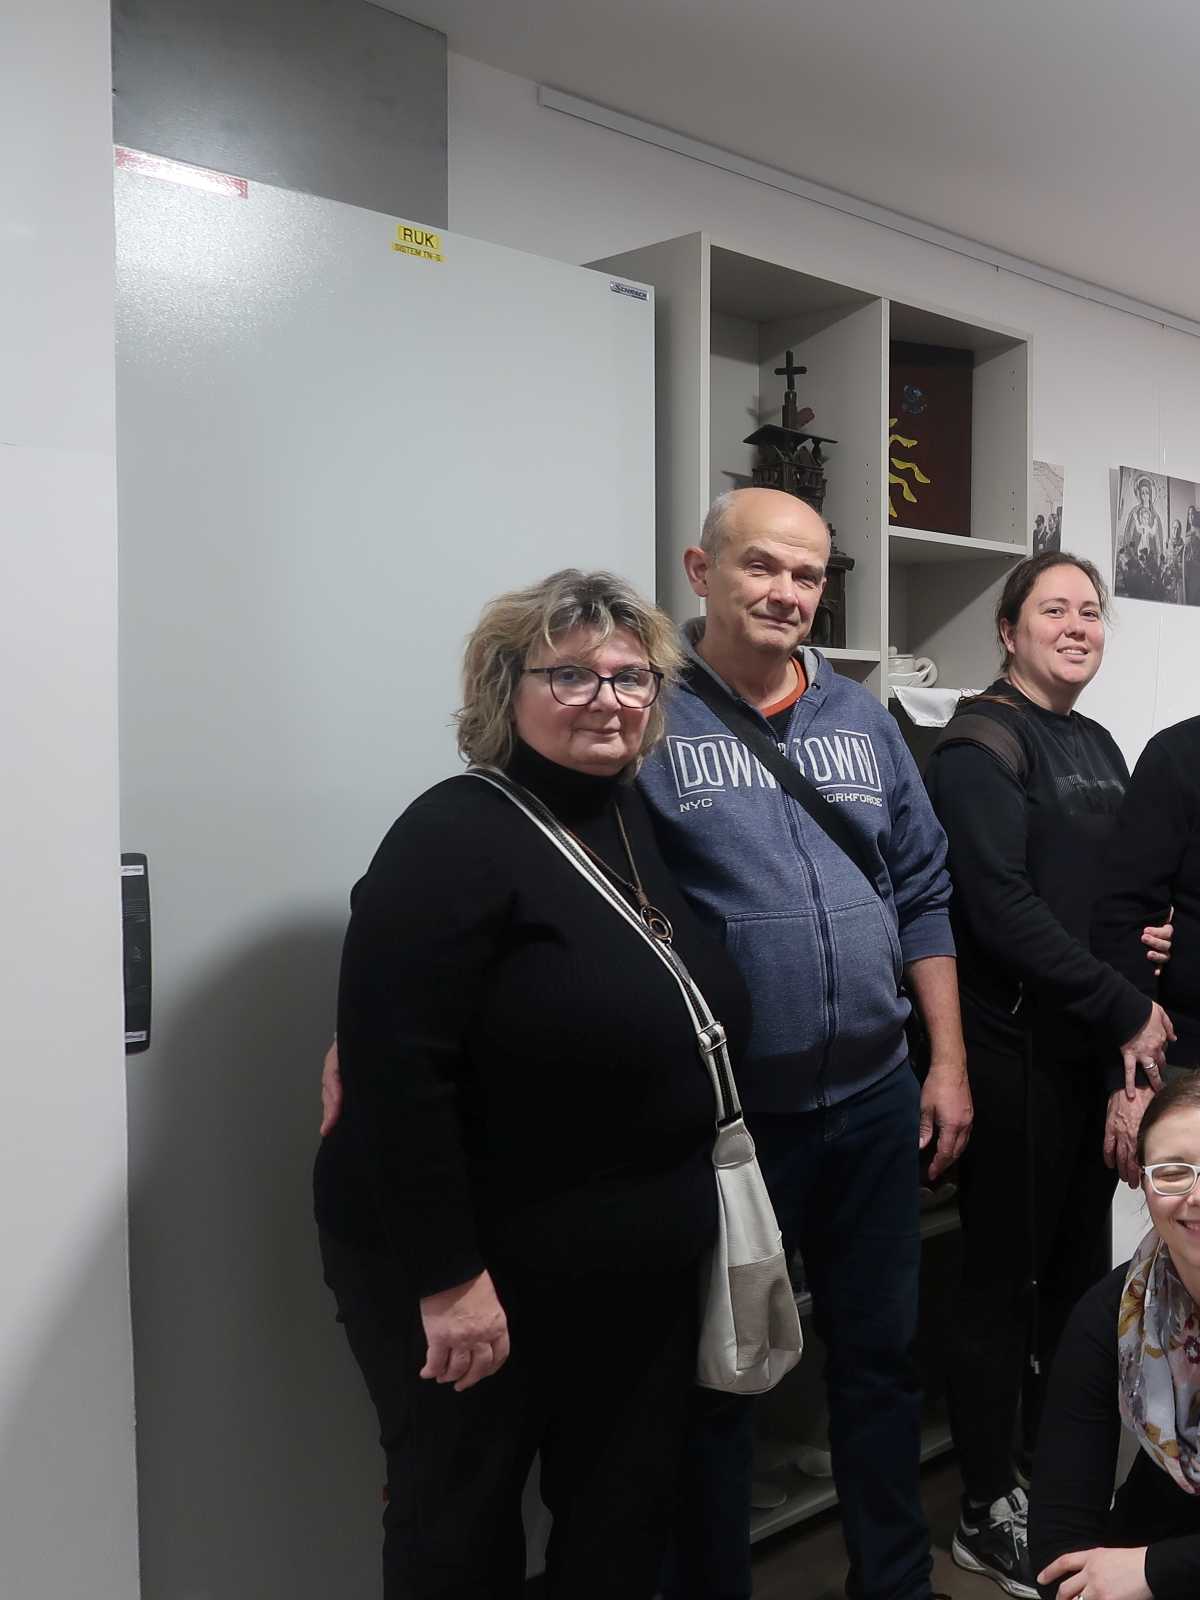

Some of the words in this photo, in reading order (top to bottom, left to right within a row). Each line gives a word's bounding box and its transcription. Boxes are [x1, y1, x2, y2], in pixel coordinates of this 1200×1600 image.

[403, 227, 434, 249] RUK
[679, 798, 713, 813] NYC
[823, 792, 882, 807] ORKFORCE
